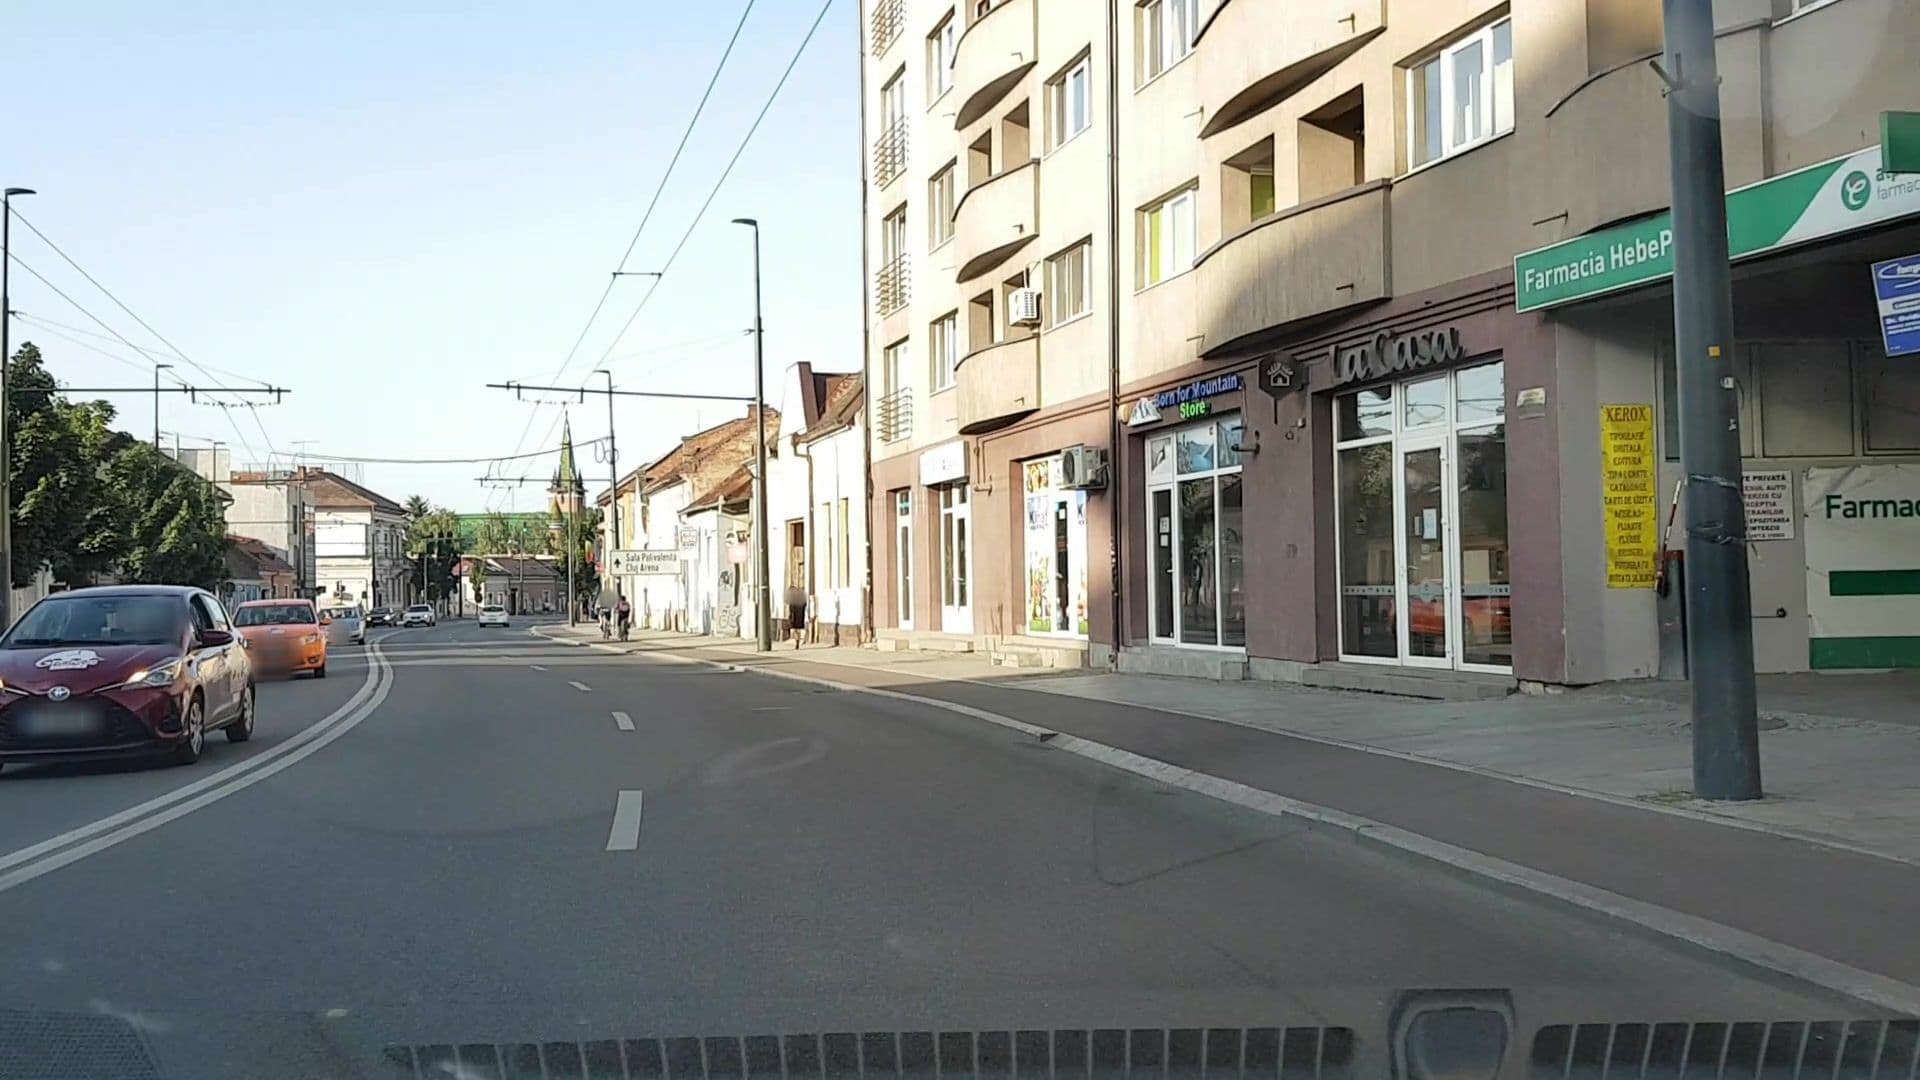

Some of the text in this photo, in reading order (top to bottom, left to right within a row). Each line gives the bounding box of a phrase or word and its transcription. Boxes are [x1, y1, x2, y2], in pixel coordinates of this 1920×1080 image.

[1525, 229, 1673, 293] Farmacia HebeP
[1370, 328, 1461, 377] Casa
[1153, 374, 1238, 408] Born for Mountain
[1179, 400, 1206, 418] Store
[1606, 407, 1648, 422] XEROX
[625, 552, 640, 562] Sala
[625, 563, 660, 574] Cluj Arena
